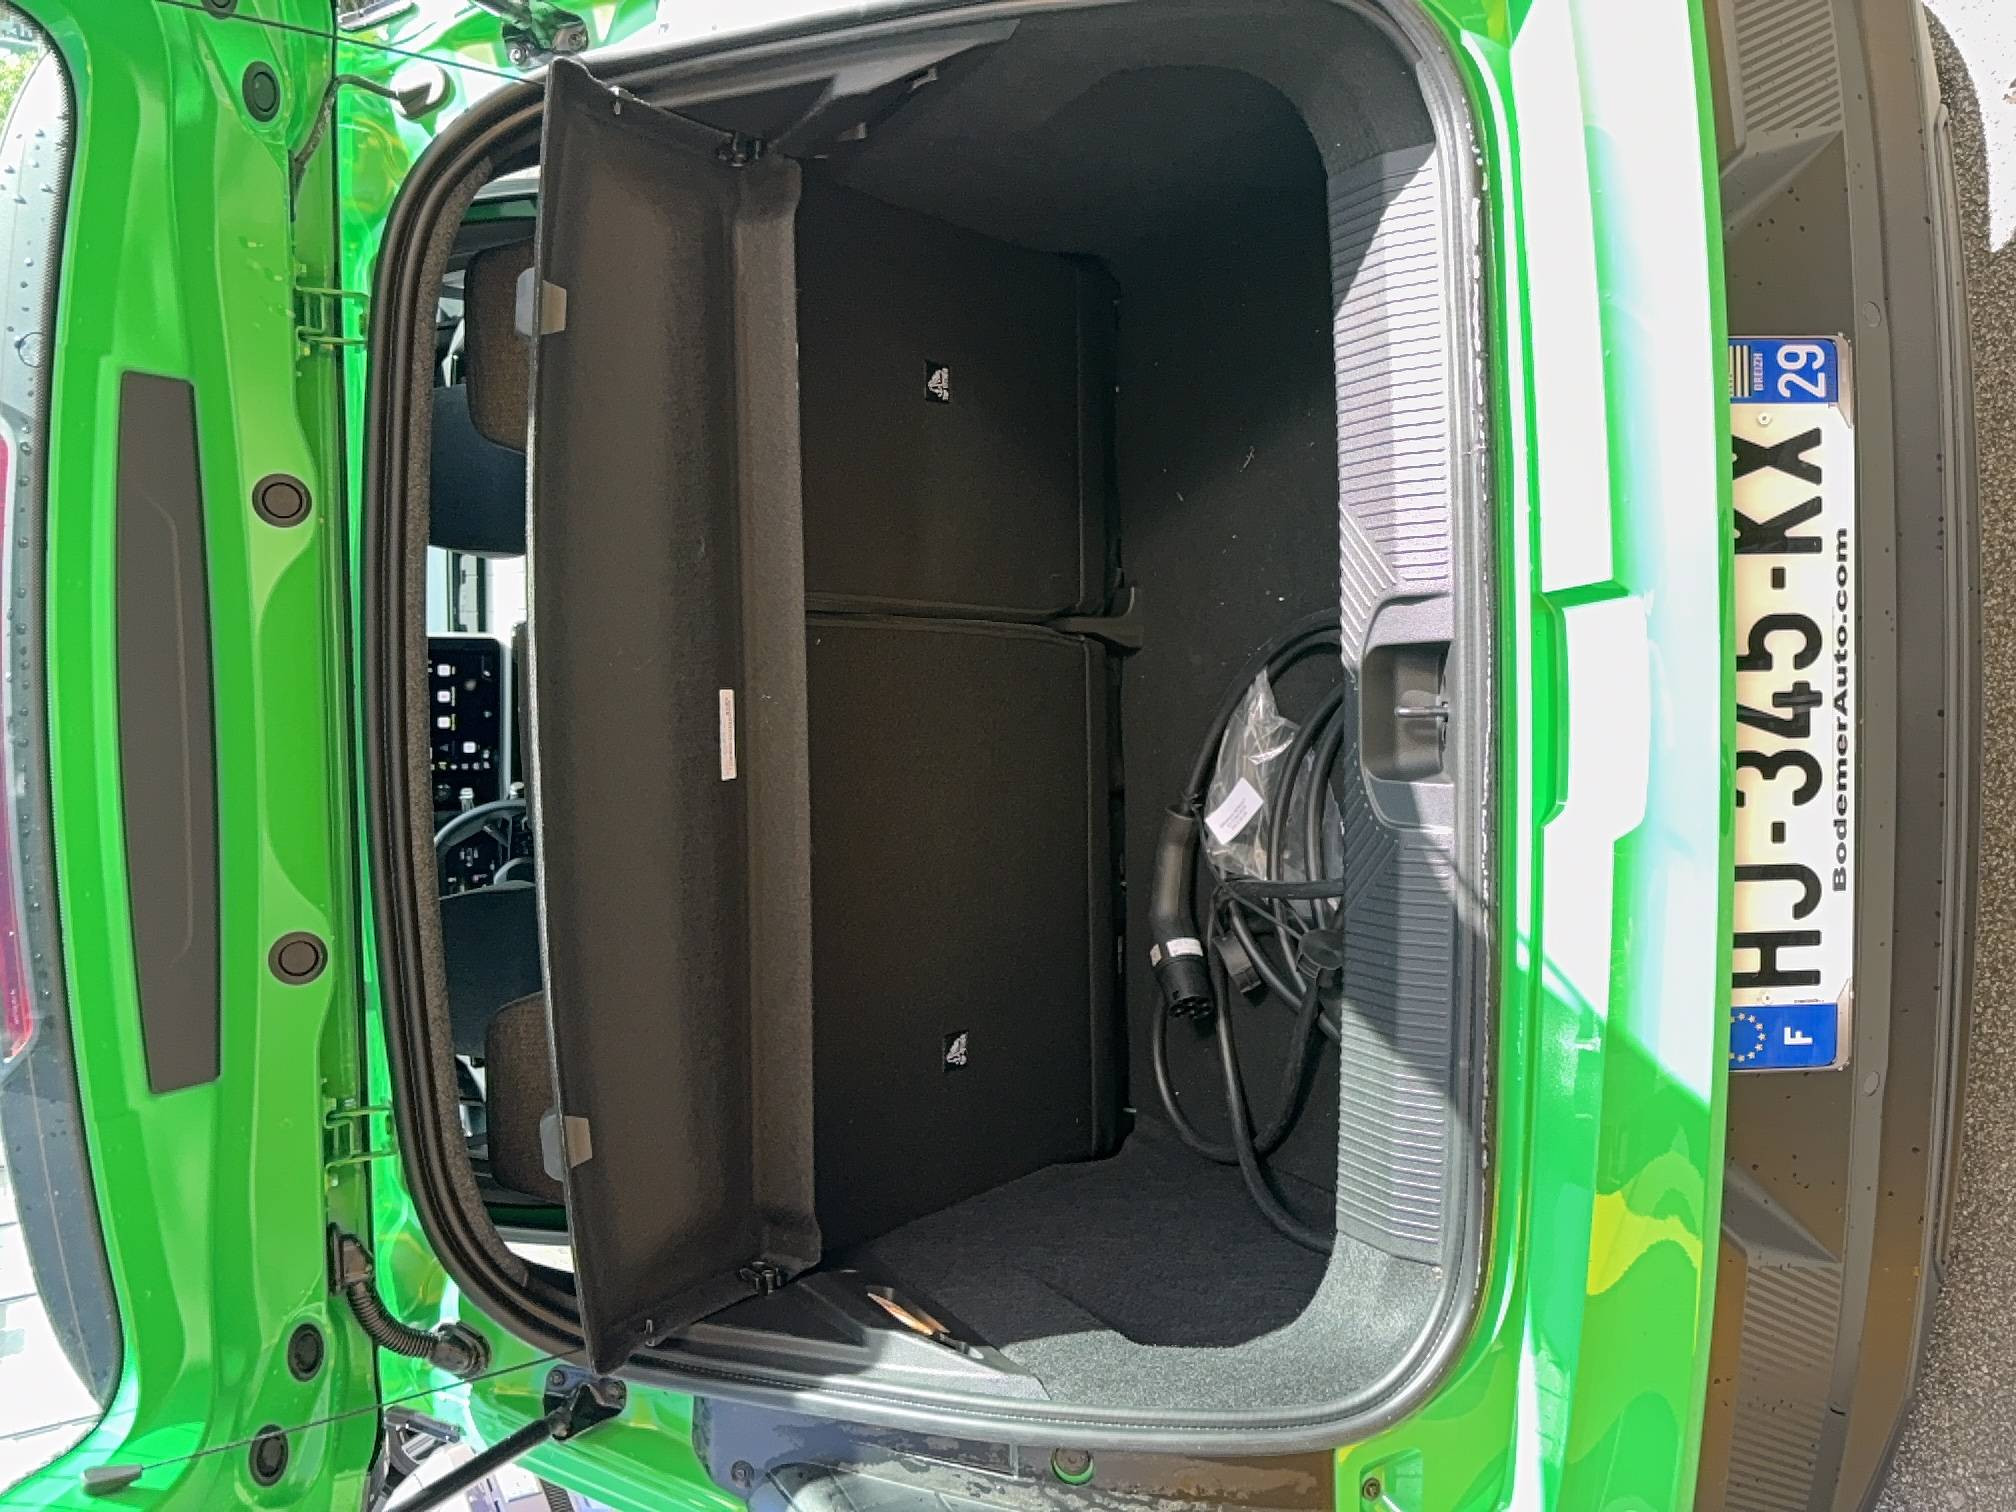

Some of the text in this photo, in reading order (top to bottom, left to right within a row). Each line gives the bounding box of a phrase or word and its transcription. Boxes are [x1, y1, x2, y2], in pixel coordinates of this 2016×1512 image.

[1753, 352, 1764, 391] BREIZH
[1776, 344, 1826, 398] 29
[1731, 426, 1823, 989] HJ-345-KX
[1832, 528, 1849, 892] BodemerAuto.com
[1783, 1026, 1813, 1046] F
